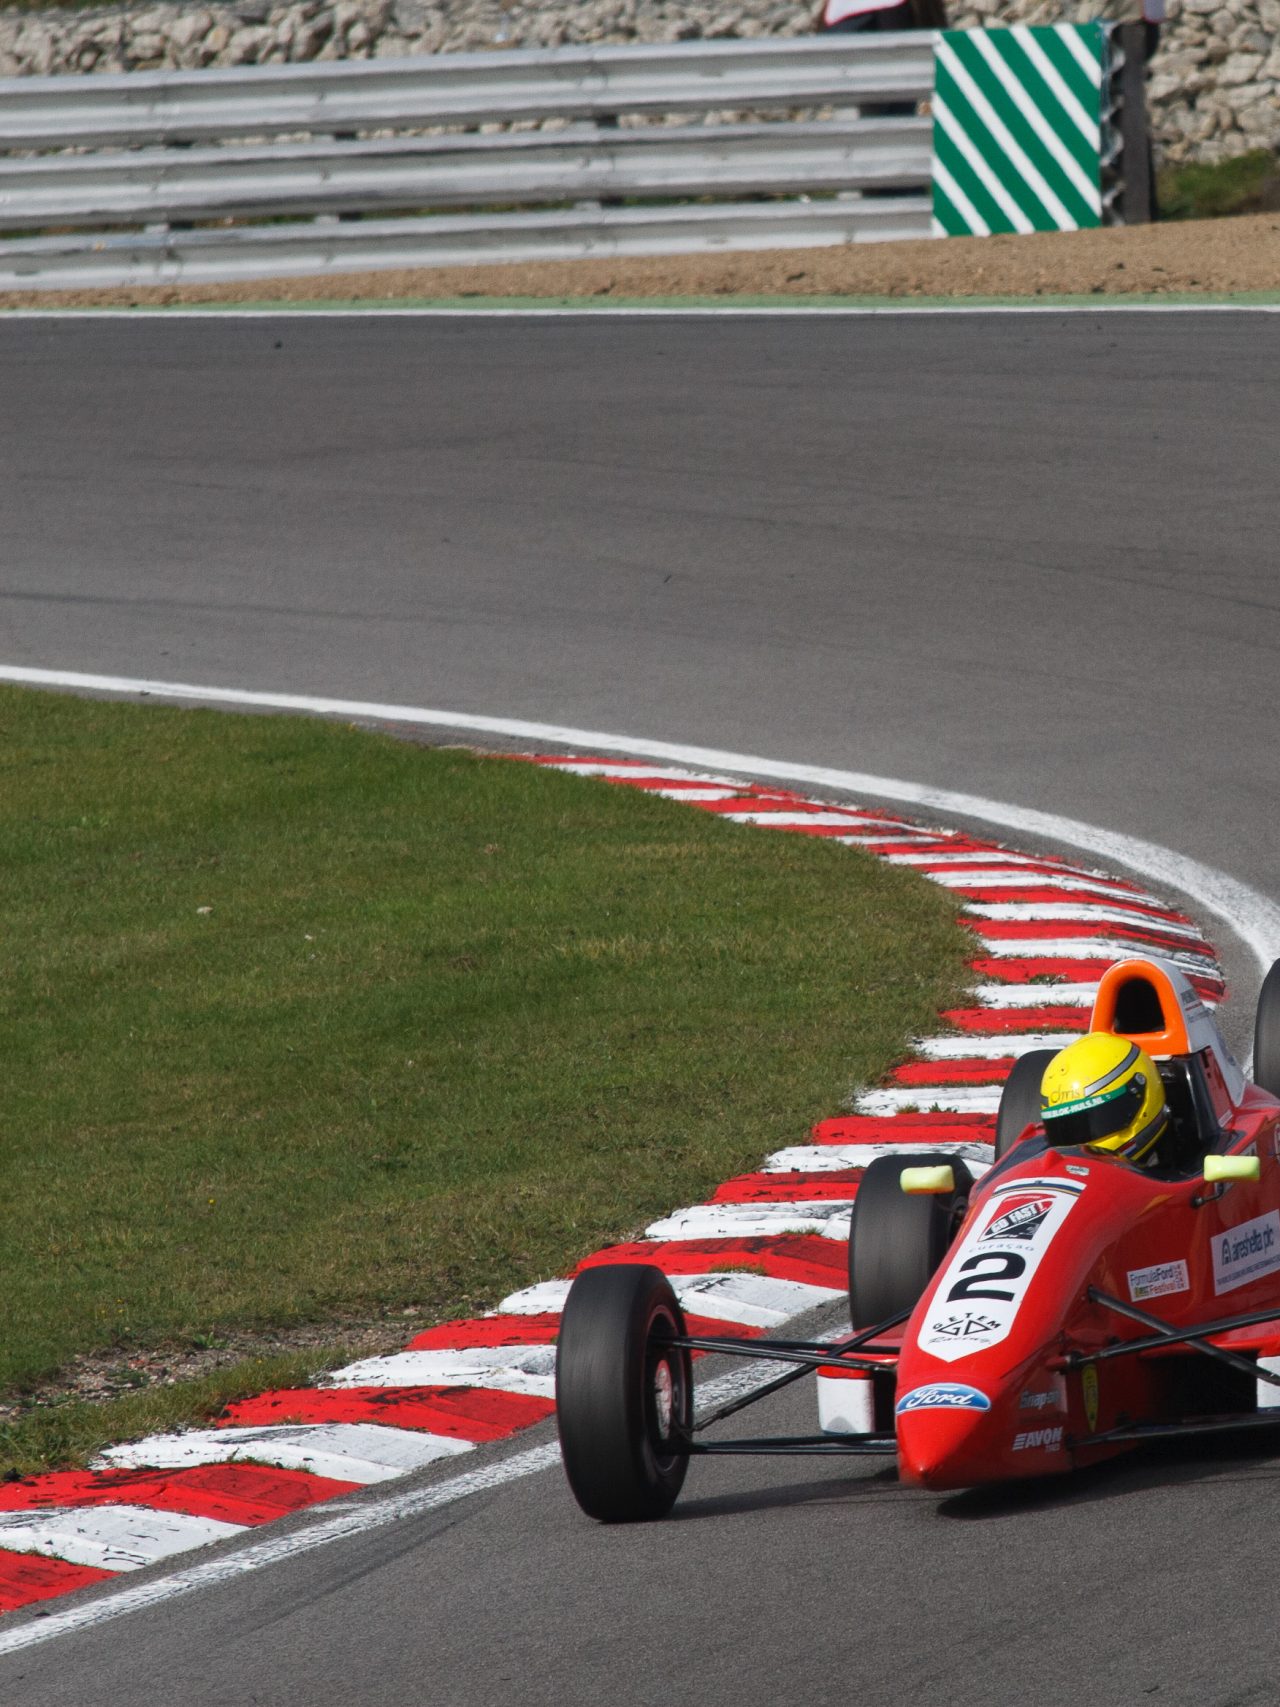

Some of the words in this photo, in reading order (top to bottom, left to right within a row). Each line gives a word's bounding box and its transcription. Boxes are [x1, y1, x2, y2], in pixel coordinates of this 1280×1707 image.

[946, 1251, 1026, 1303] 2
[906, 1387, 976, 1409] Ford
[1022, 1426, 1064, 1450] AVON
